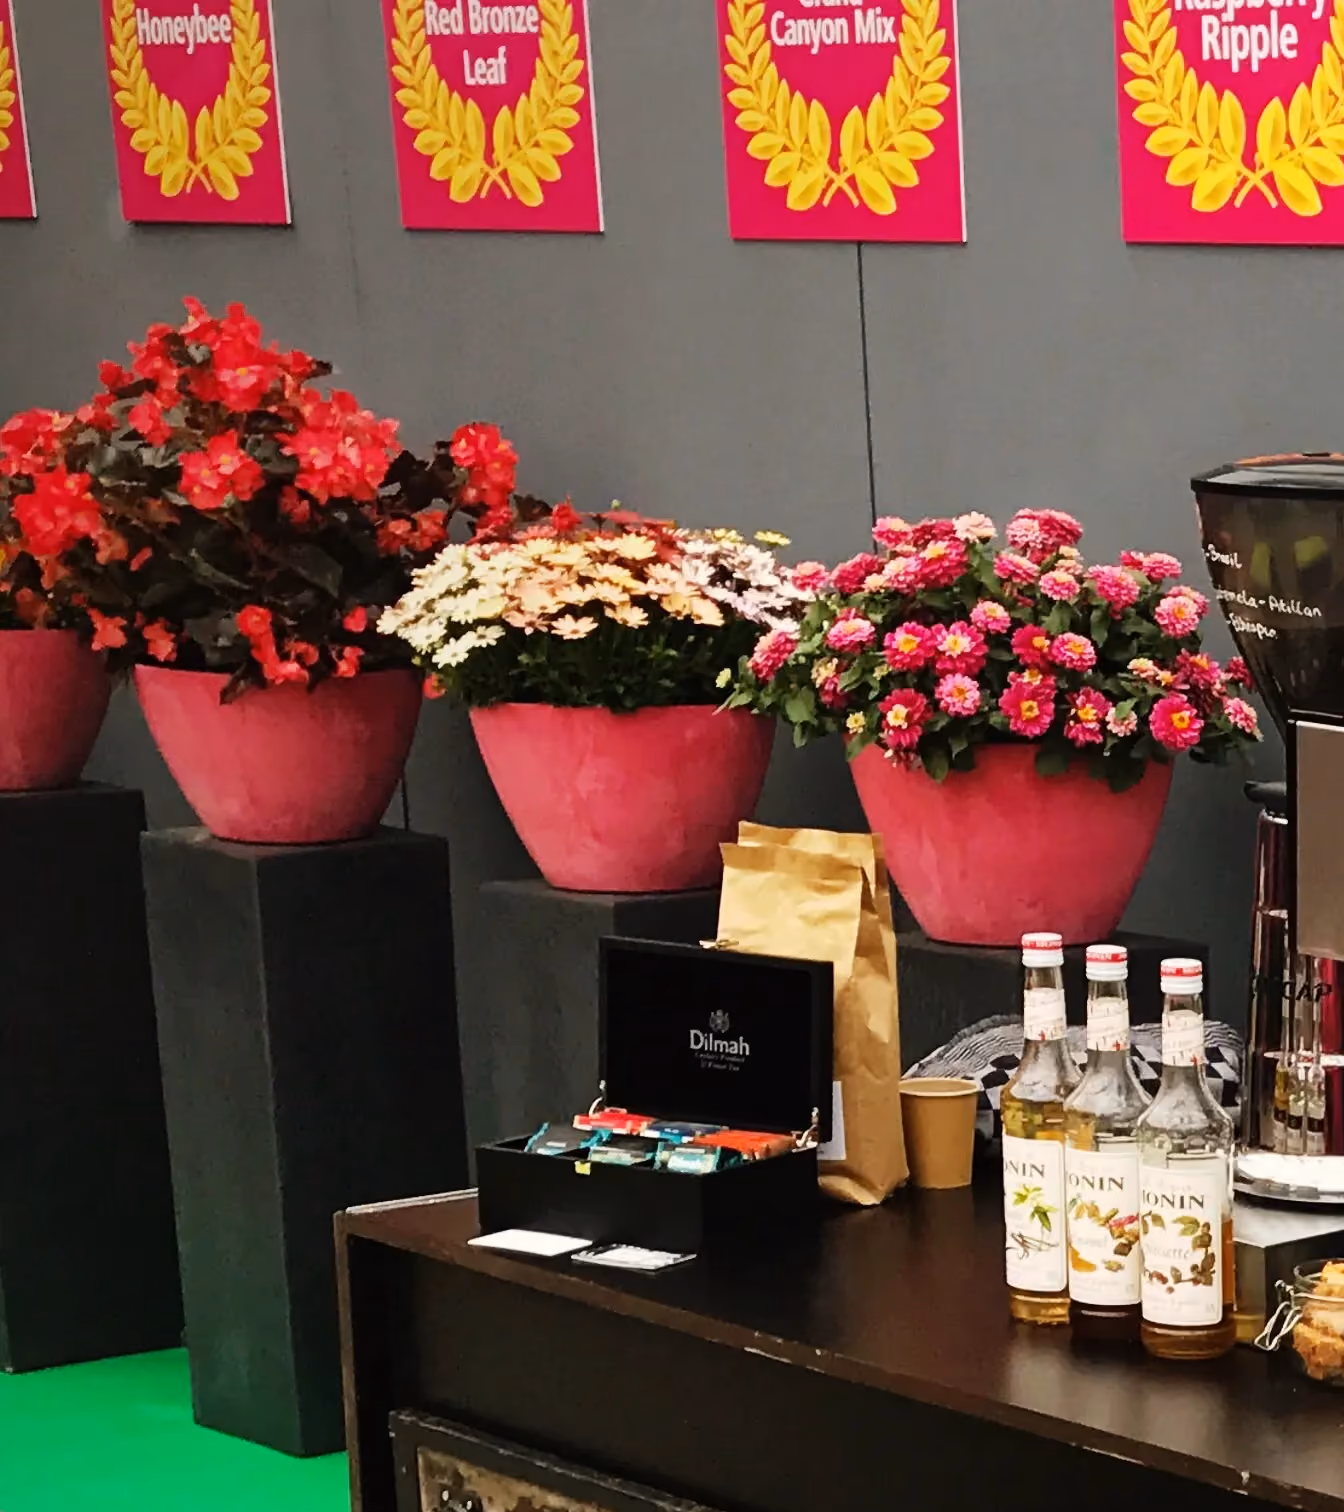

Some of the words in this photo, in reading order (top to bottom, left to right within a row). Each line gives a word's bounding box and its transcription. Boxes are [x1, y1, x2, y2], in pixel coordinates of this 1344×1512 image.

[136, 3, 232, 54] Honeybee
[425, 0, 464, 35] Red
[468, 0, 539, 34] Bronze
[770, 10, 849, 55] Canyon
[854, 6, 896, 44] Mix
[1201, 9, 1298, 73] Ripple
[463, 46, 507, 85] Leaf
[689, 1029, 750, 1056] Dilmah
[1068, 1174, 1125, 1192] ONIN
